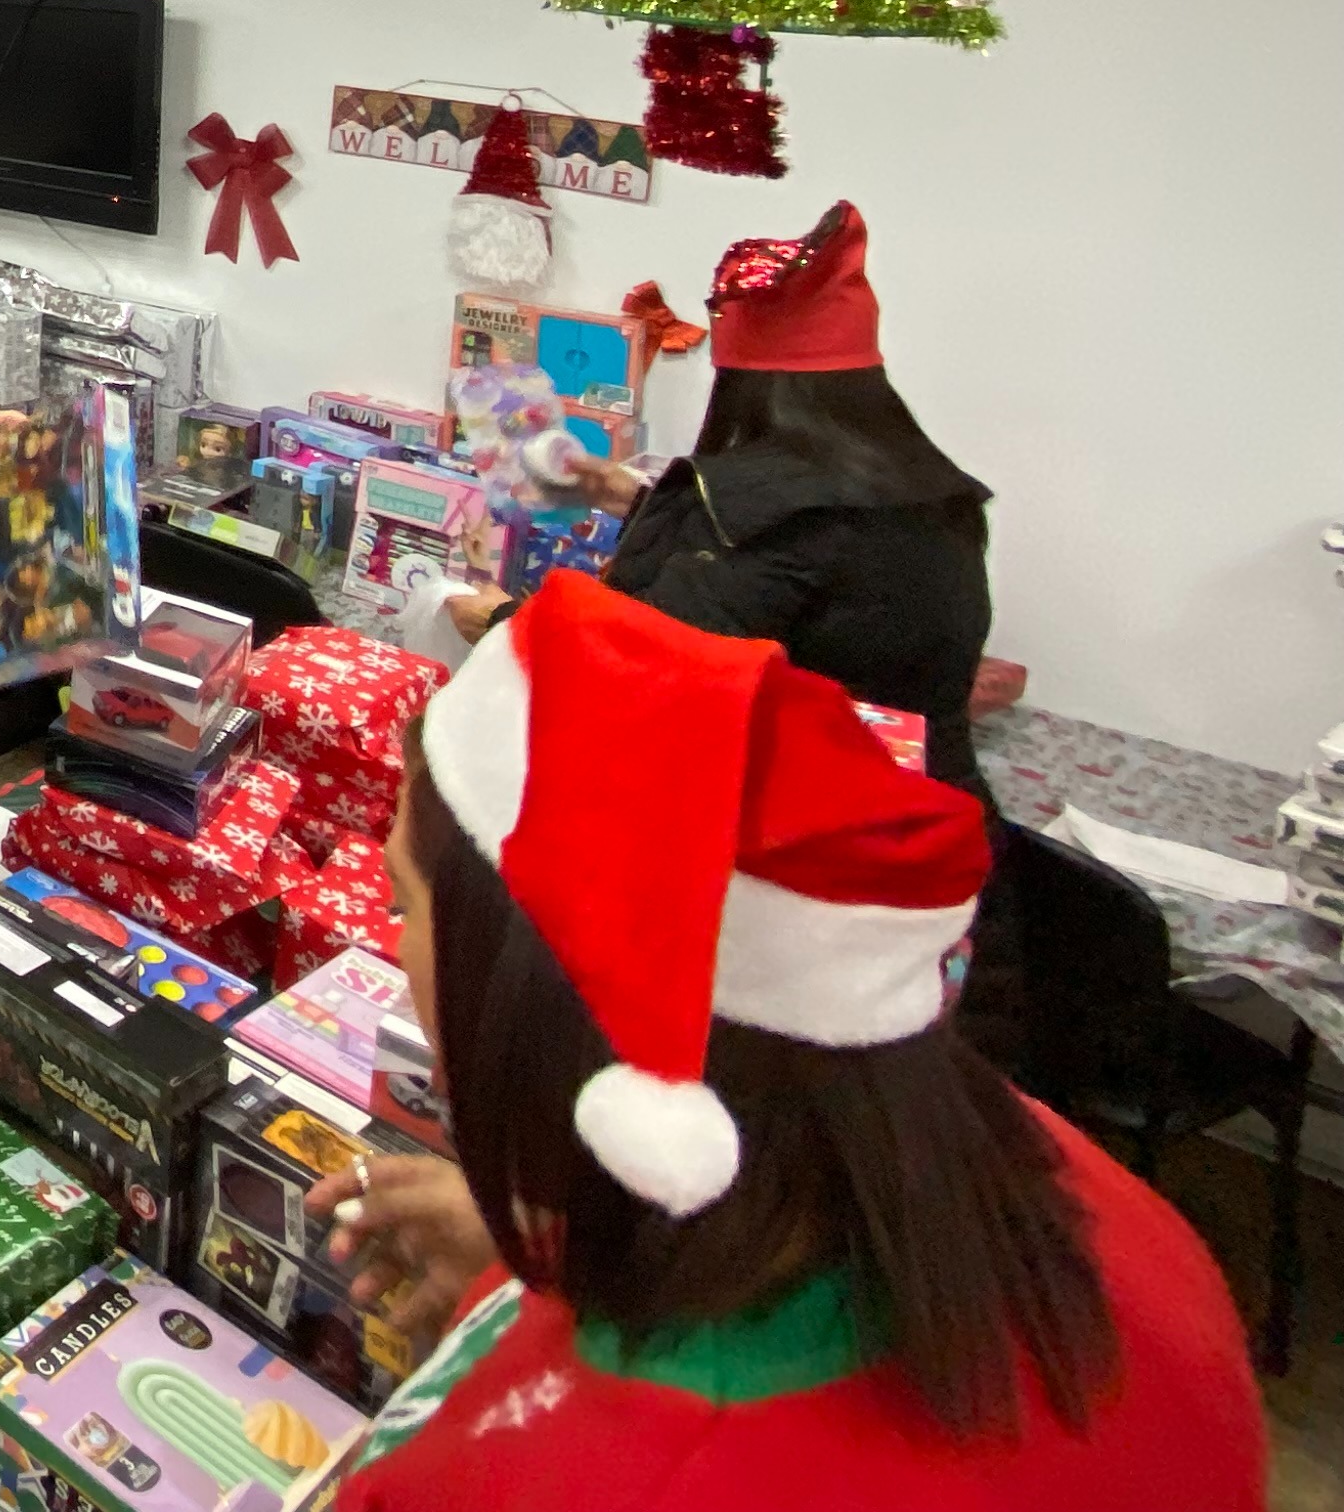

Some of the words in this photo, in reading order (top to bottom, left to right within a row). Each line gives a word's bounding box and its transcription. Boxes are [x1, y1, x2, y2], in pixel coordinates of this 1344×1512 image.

[340, 129, 633, 196] WELME
[463, 307, 528, 327] JEWELRY
[35, 1291, 134, 1377] CANDLES
